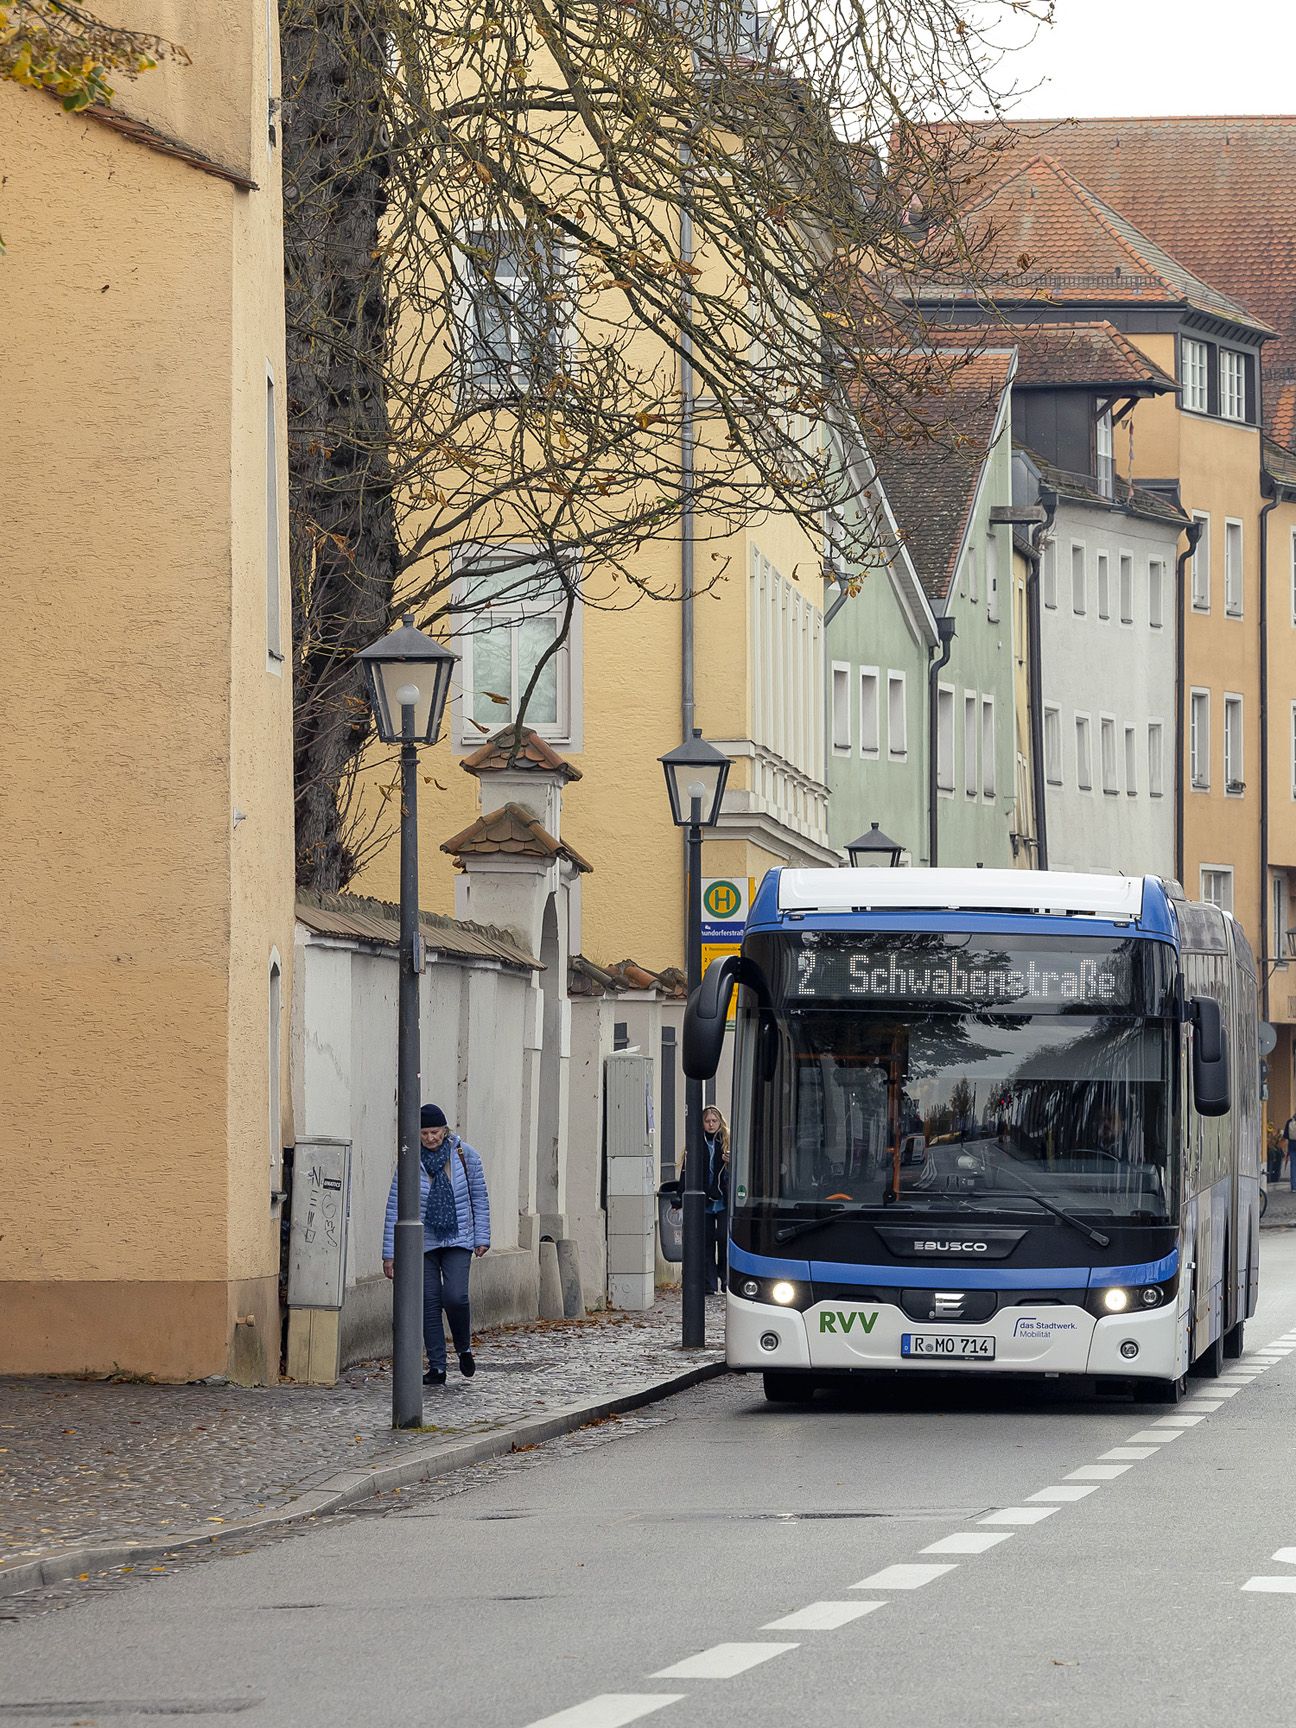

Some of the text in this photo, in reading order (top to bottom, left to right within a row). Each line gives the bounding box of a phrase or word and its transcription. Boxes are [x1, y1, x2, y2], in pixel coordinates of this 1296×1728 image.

[799, 951, 1116, 1000] 2 Schwabenstraße
[914, 1241, 988, 1252] EBUSCO
[819, 1311, 879, 1334] RVV
[1019, 1321, 1078, 1330] das Stadtwerk.
[1019, 1330, 1051, 1338] Mobilität
[914, 1337, 989, 1354] R MO 714
